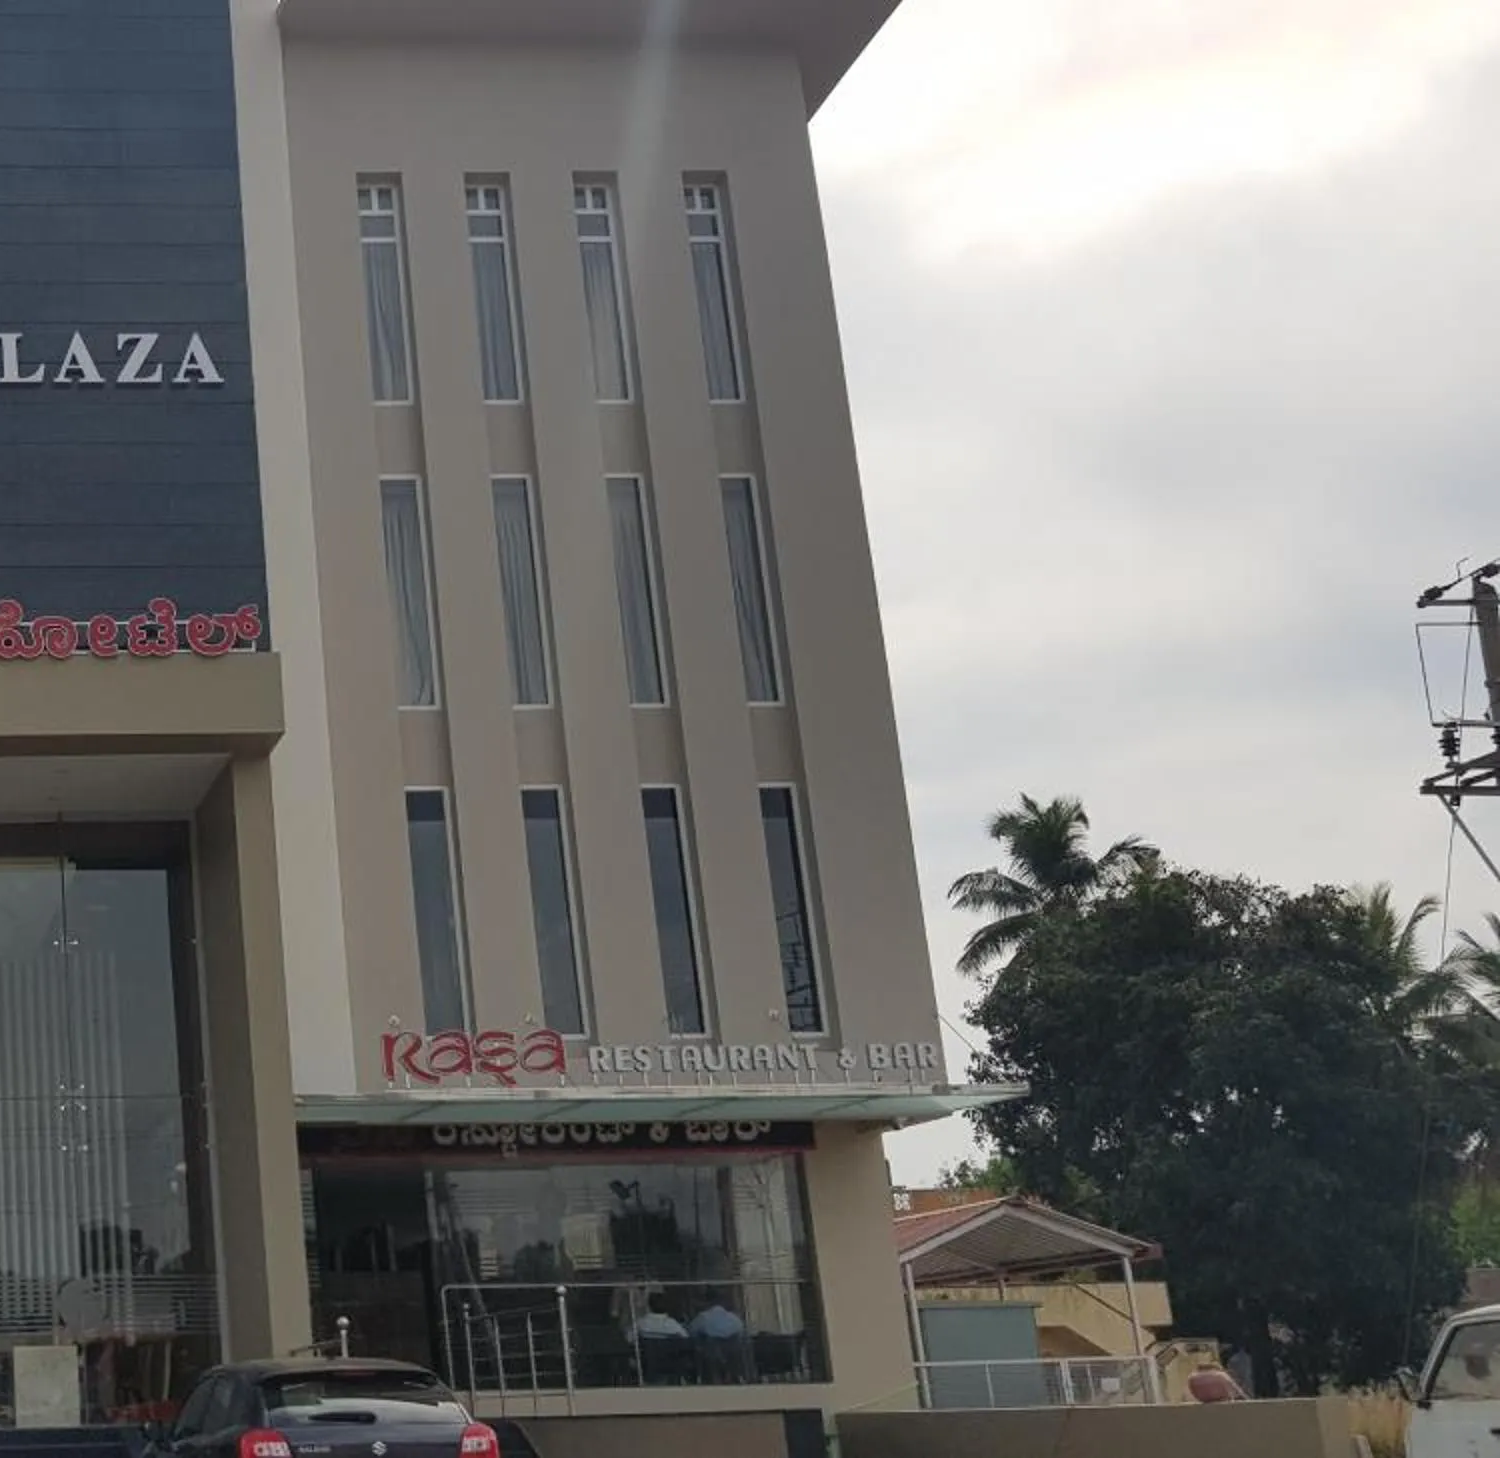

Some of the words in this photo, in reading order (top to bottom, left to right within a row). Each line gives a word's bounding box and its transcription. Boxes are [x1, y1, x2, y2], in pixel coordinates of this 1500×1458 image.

[588, 1043, 820, 1073] RESTAURANT
[837, 1049, 857, 1072] &
[866, 1042, 938, 1072] BAR
